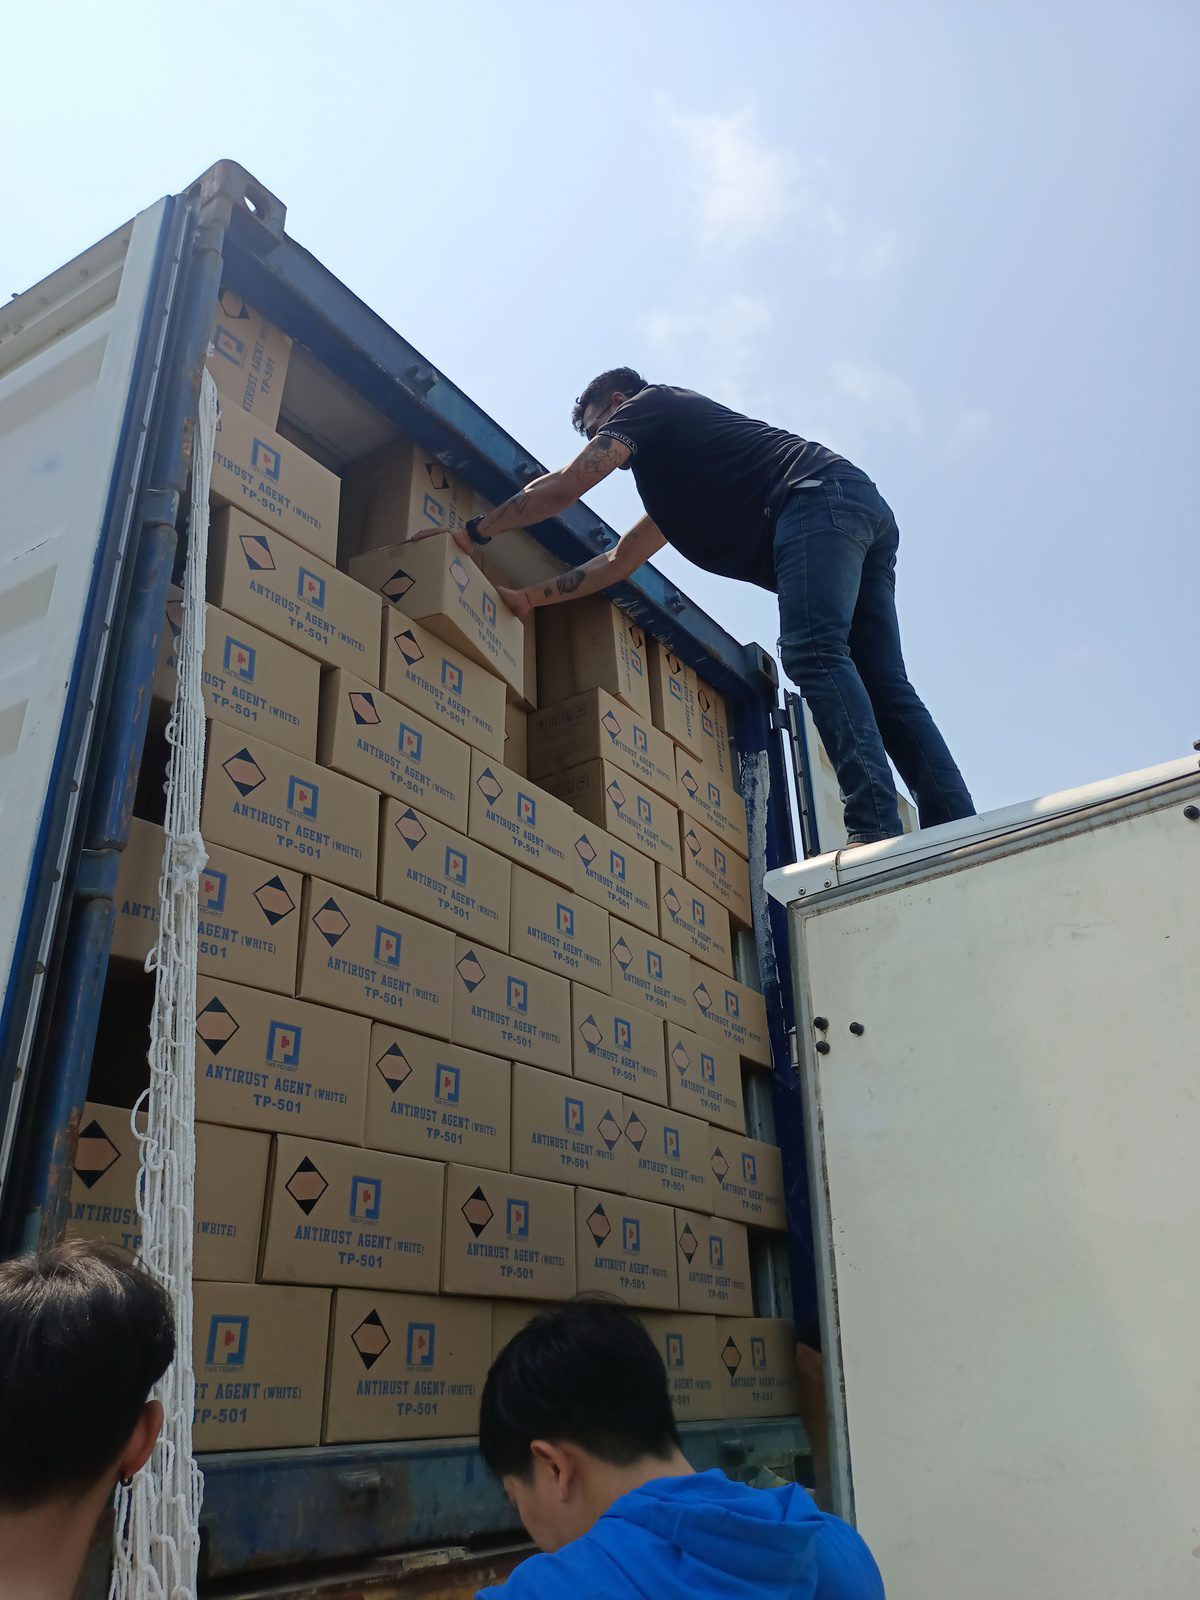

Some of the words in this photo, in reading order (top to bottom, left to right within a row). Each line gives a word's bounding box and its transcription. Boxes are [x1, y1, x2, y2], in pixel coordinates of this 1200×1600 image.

[261, 359, 275, 394] TP-501
[241, 484, 282, 517] TP-501
[259, 481, 291, 508] AGENT
[292, 506, 321, 530] (WHITE)
[249, 580, 300, 616] ANTIRUST
[305, 612, 336, 636] AGENT
[338, 631, 365, 652] (WHITE)
[459, 596, 484, 629] ANTIRUST
[288, 616, 328, 645] TP-501
[213, 693, 257, 721] TP-501
[232, 685, 267, 710] AGENT
[270, 705, 300, 727] (WHITE)
[406, 670, 444, 699] ANTIRUST
[447, 697, 471, 716] AGENT
[472, 715, 494, 734] (WHITE)
[435, 702, 465, 726] TP-501
[357, 738, 401, 770] ANTIRUST
[404, 765, 431, 787] AGENT
[432, 783, 456, 801] (WHITE)
[390, 771, 425, 797] TP-501
[233, 802, 290, 831] ANTIRUST
[296, 825, 330, 846] AGENT
[332, 841, 362, 859] (WHITE)
[486, 809, 520, 837] ANTIRUST
[523, 830, 544, 848] AGENT
[545, 843, 565, 860] (WHITE)
[277, 834, 321, 859] TP-501
[512, 836, 540, 857] TP-501
[406, 868, 448, 895] ANTIRUST
[451, 889, 476, 909] AGENT
[477, 904, 499, 920] (WHITE)
[616, 885, 633, 900] AGENT
[438, 898, 470, 920] TP-501
[198, 921, 239, 943] AGENT
[241, 936, 277, 955] (WHITE)
[527, 925, 560, 948] ANTIRUST
[563, 941, 582, 959] AGENT
[583, 951, 601, 967] (WHITE)
[552, 950, 579, 968] TP-501
[327, 956, 377, 982] ANTIRUST
[381, 974, 411, 994] AGENT
[413, 988, 439, 1004] (WHITE)
[653, 984, 671, 999] AGENT
[364, 986, 403, 1008] TP-501
[471, 1005, 510, 1027] ANTIRUST
[513, 1020, 538, 1038] AGENT
[538, 1030, 560, 1044] (WHITE)
[501, 1030, 532, 1048] TP-501
[612, 1066, 636, 1082] TP-501
[621, 1055, 640, 1069] AGENT
[205, 1063, 269, 1089] ANTIRUST
[275, 1077, 312, 1097] AGENT
[314, 1088, 347, 1104] (WHITE)
[254, 1094, 302, 1114] TP-501
[707, 1089, 723, 1103] AGENT
[390, 1101, 438, 1122] ANTIRUST
[441, 1113, 470, 1130] AGENT
[471, 1122, 496, 1136] (WHITE)
[426, 1127, 463, 1145] TP-501
[532, 1132, 569, 1150] ANTIRUST
[572, 1141, 594, 1156] AGENT
[561, 1154, 589, 1169] TP-501
[638, 1158, 668, 1176] ANTIRUST
[670, 1167, 688, 1180] AGENT
[661, 1178, 685, 1192] TP-501
[197, 1222, 237, 1238] (WHITE)
[295, 1225, 352, 1245] ANTIRUST
[357, 1233, 392, 1250] AGENT
[394, 1241, 424, 1255] (WHITE)
[338, 1252, 383, 1268] TP-501
[467, 1242, 510, 1260] ANTIRUST
[513, 1249, 539, 1263] AGENT
[541, 1255, 565, 1267] (WHITE)
[594, 1256, 627, 1272] ANTIRUST
[630, 1260, 649, 1276] AGENT
[500, 1265, 534, 1280] TP-501
[620, 1277, 645, 1290] TP-501
[715, 1275, 731, 1287] AGENT
[215, 1383, 260, 1400] AGENT
[263, 1386, 302, 1399] (WHITE)
[356, 1380, 409, 1395] ANTIRUST
[414, 1381, 446, 1395] AGENT
[448, 1384, 476, 1396] (WHITE)
[397, 1402, 438, 1416] TP-501
